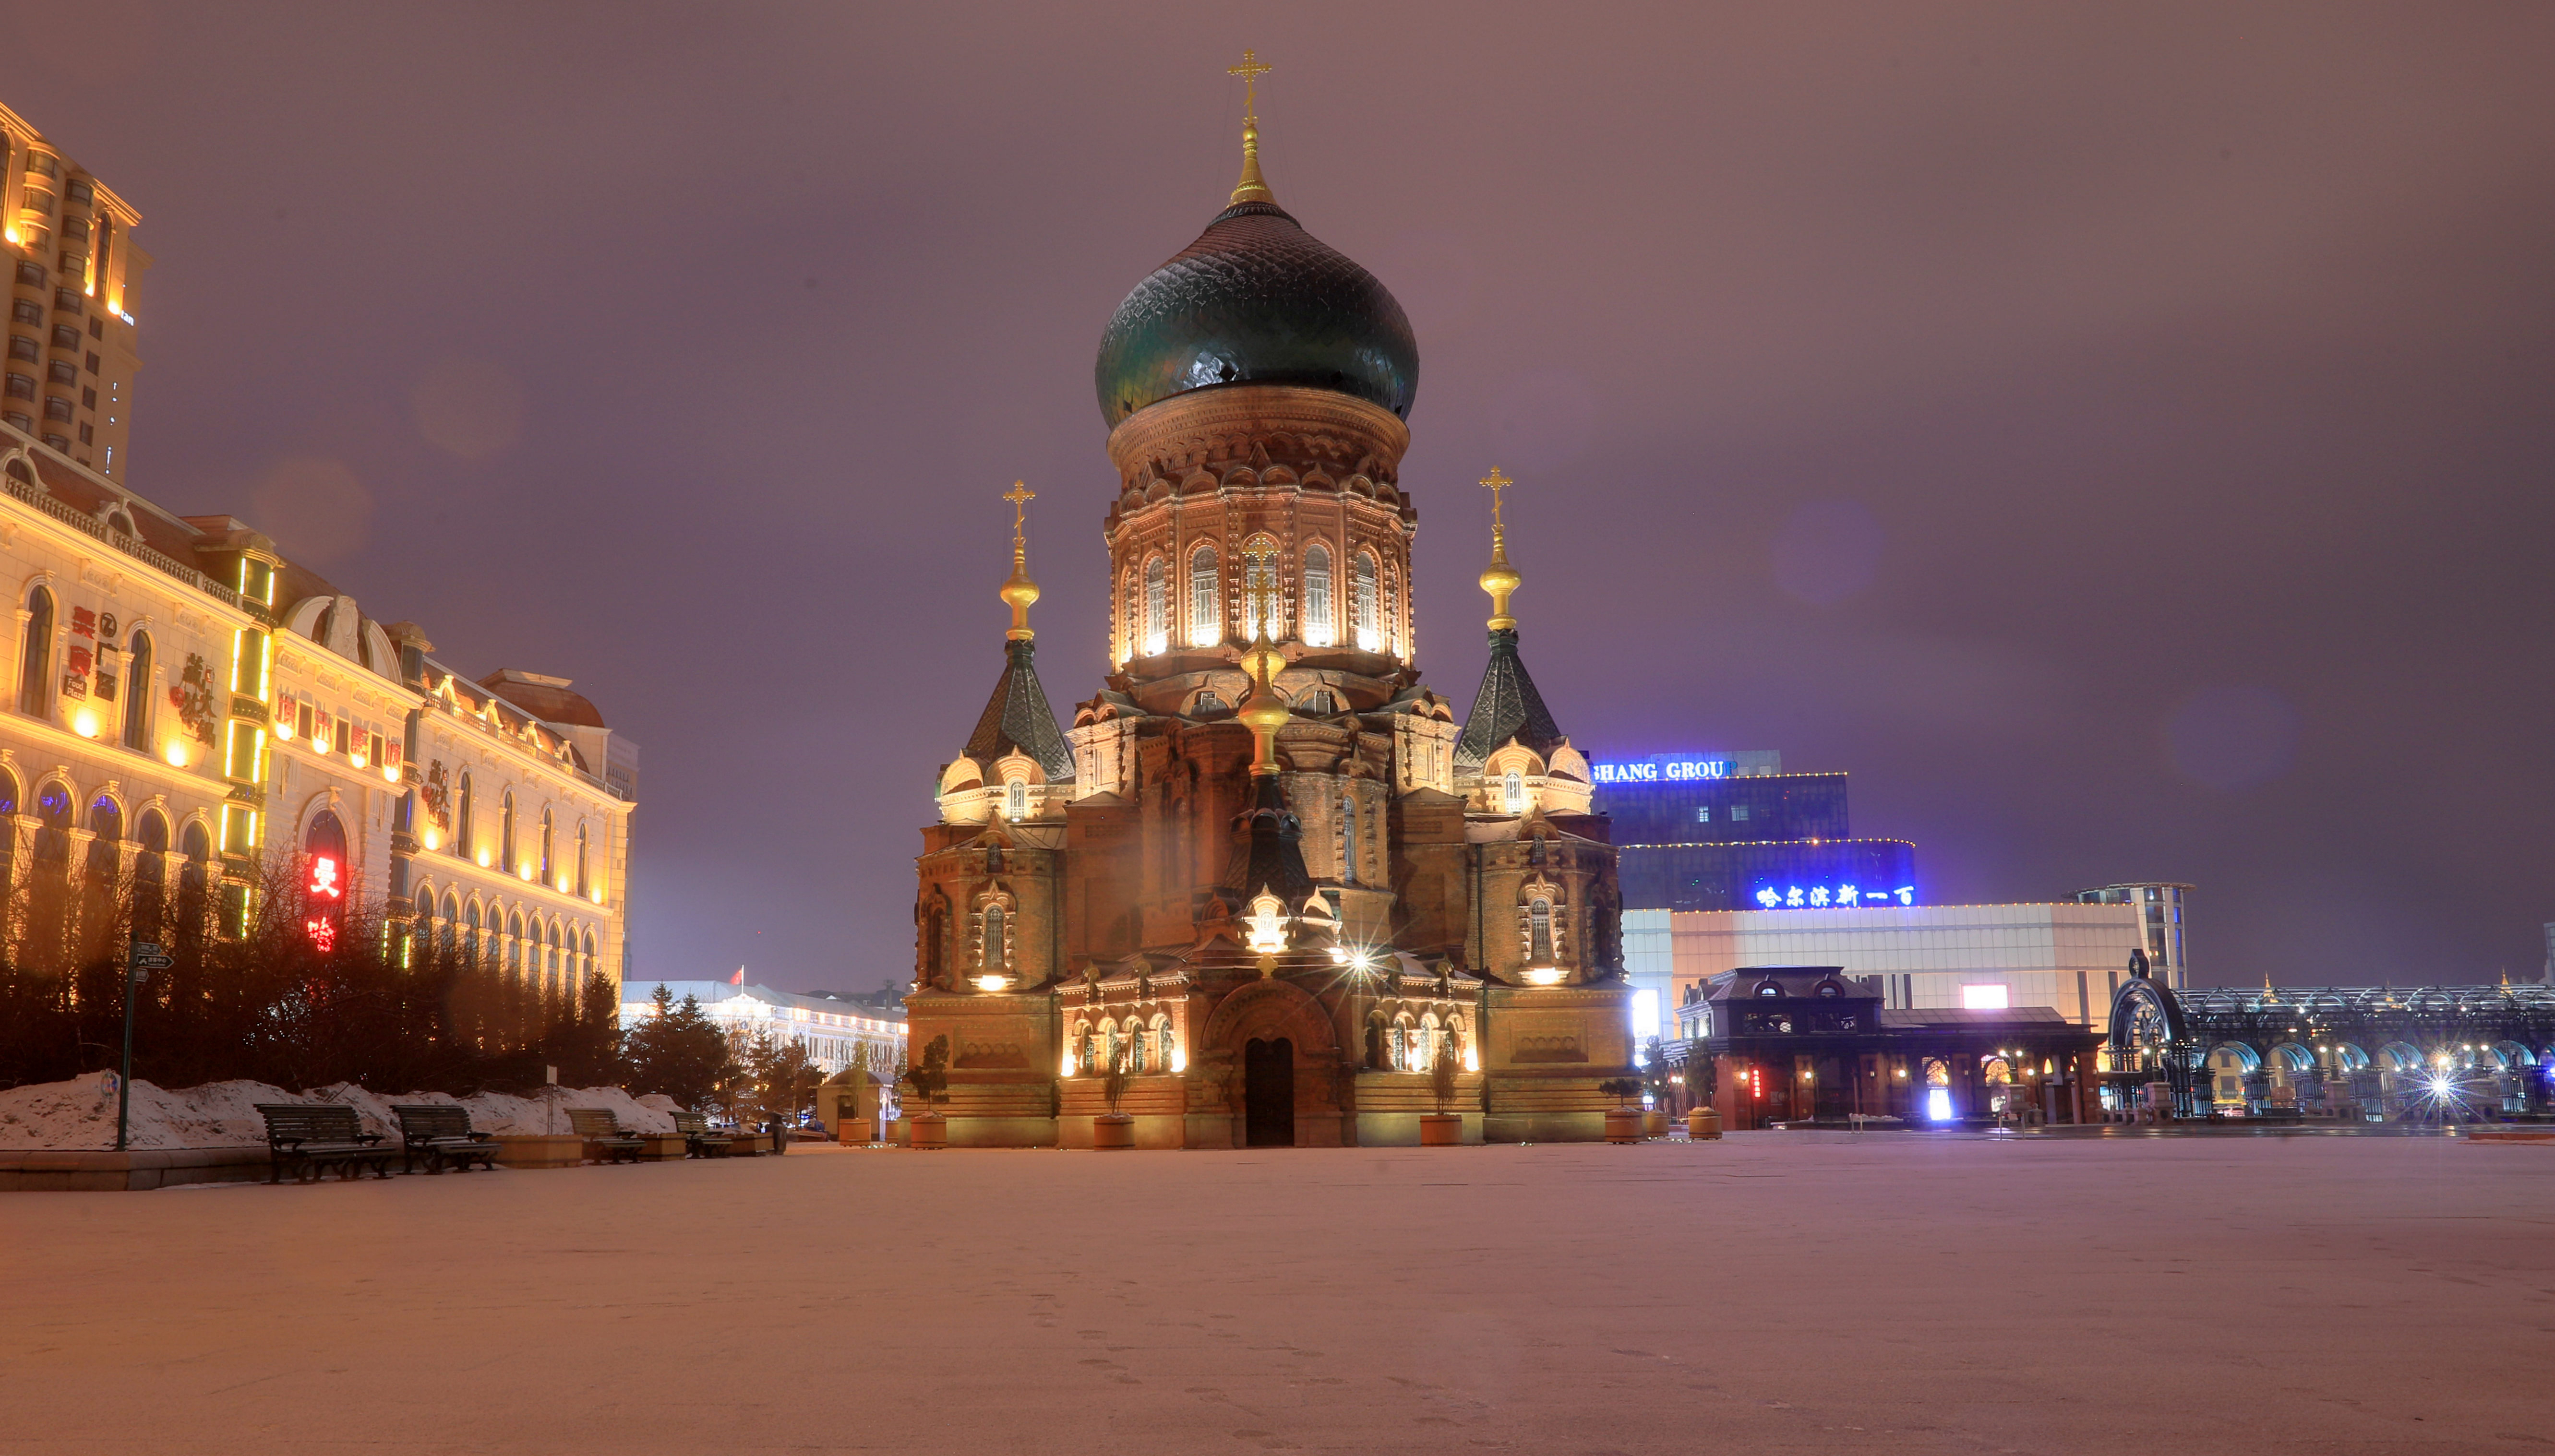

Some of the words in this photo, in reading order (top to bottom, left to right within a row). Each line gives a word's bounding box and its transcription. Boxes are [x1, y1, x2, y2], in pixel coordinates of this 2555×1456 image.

[68, 678, 84, 691] Food
[67, 687, 85, 701] Plaza
[1666, 761, 1738, 778] GROUP
[1756, 883, 1914, 907] 哈尔滨新一百
